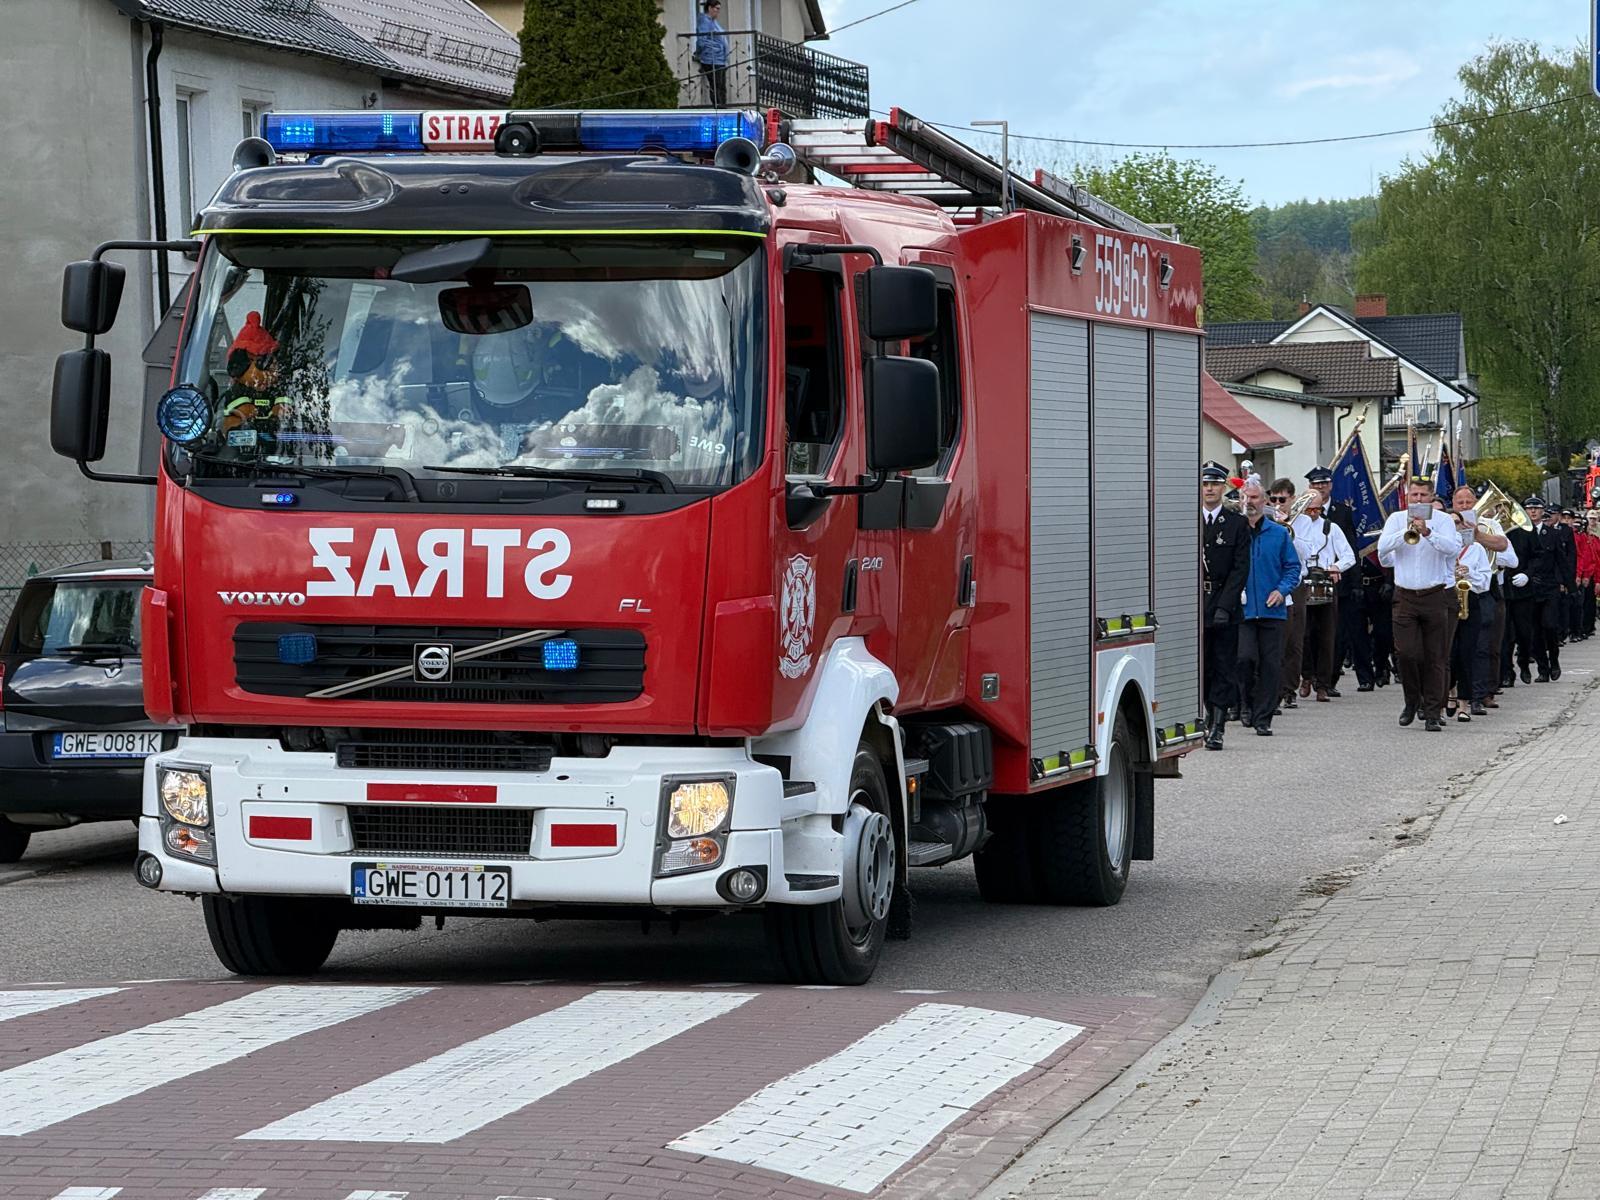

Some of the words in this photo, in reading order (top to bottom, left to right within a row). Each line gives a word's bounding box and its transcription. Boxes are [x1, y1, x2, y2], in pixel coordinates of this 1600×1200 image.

[861, 557, 883, 570] 240
[216, 591, 306, 606] VOLVO
[618, 598, 652, 612] FL
[63, 734, 98, 752] GWE
[103, 733, 159, 753] 0081K
[354, 886, 365, 894] PL
[368, 870, 417, 898] GWE
[426, 871, 506, 901] 01112
